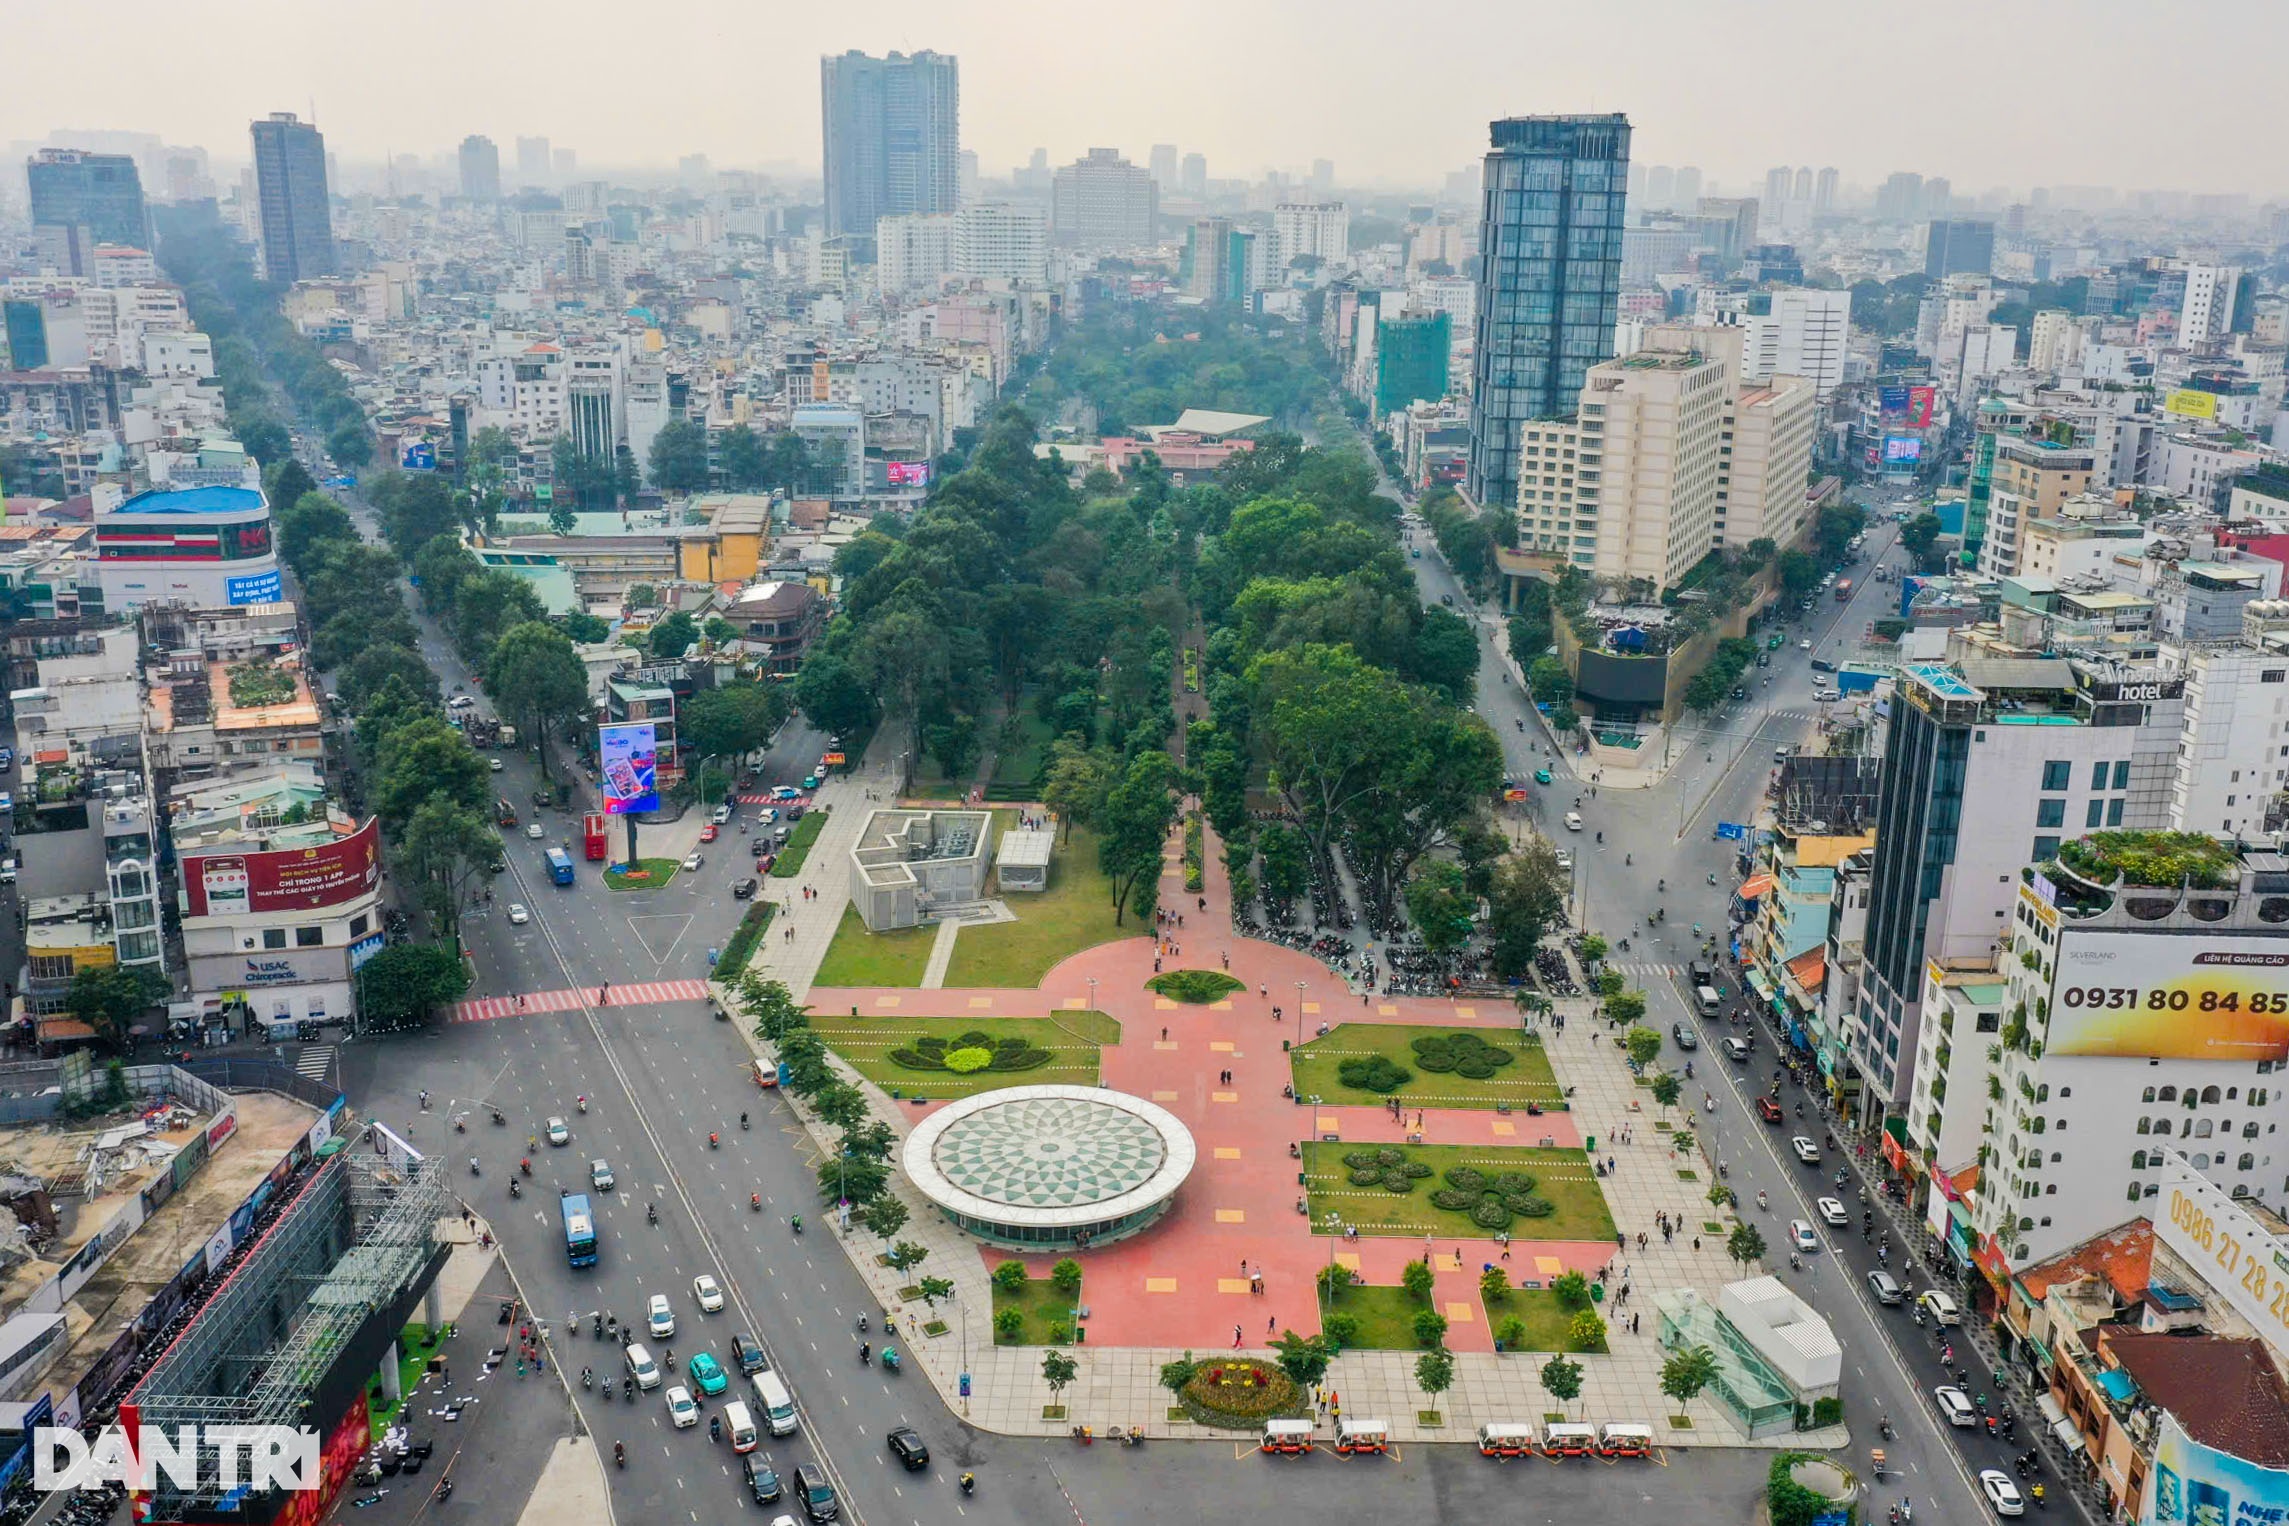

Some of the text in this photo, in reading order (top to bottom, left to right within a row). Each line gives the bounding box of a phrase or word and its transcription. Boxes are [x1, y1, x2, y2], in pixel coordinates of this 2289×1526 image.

[2118, 683, 2162, 700] hotel
[295, 876, 322, 886] TRONG
[330, 871, 344, 880] APP
[2204, 954, 2221, 962] LIÊN
[2222, 954, 2232, 963] HỆ
[260, 961, 290, 972] USAC
[246, 969, 297, 982] Chiropractic
[2063, 986, 2288, 1014] 0931 80 84 85
[2170, 1189, 2215, 1253] 0986
[2216, 1231, 2242, 1275] 27
[2241, 1255, 2268, 1303] 28
